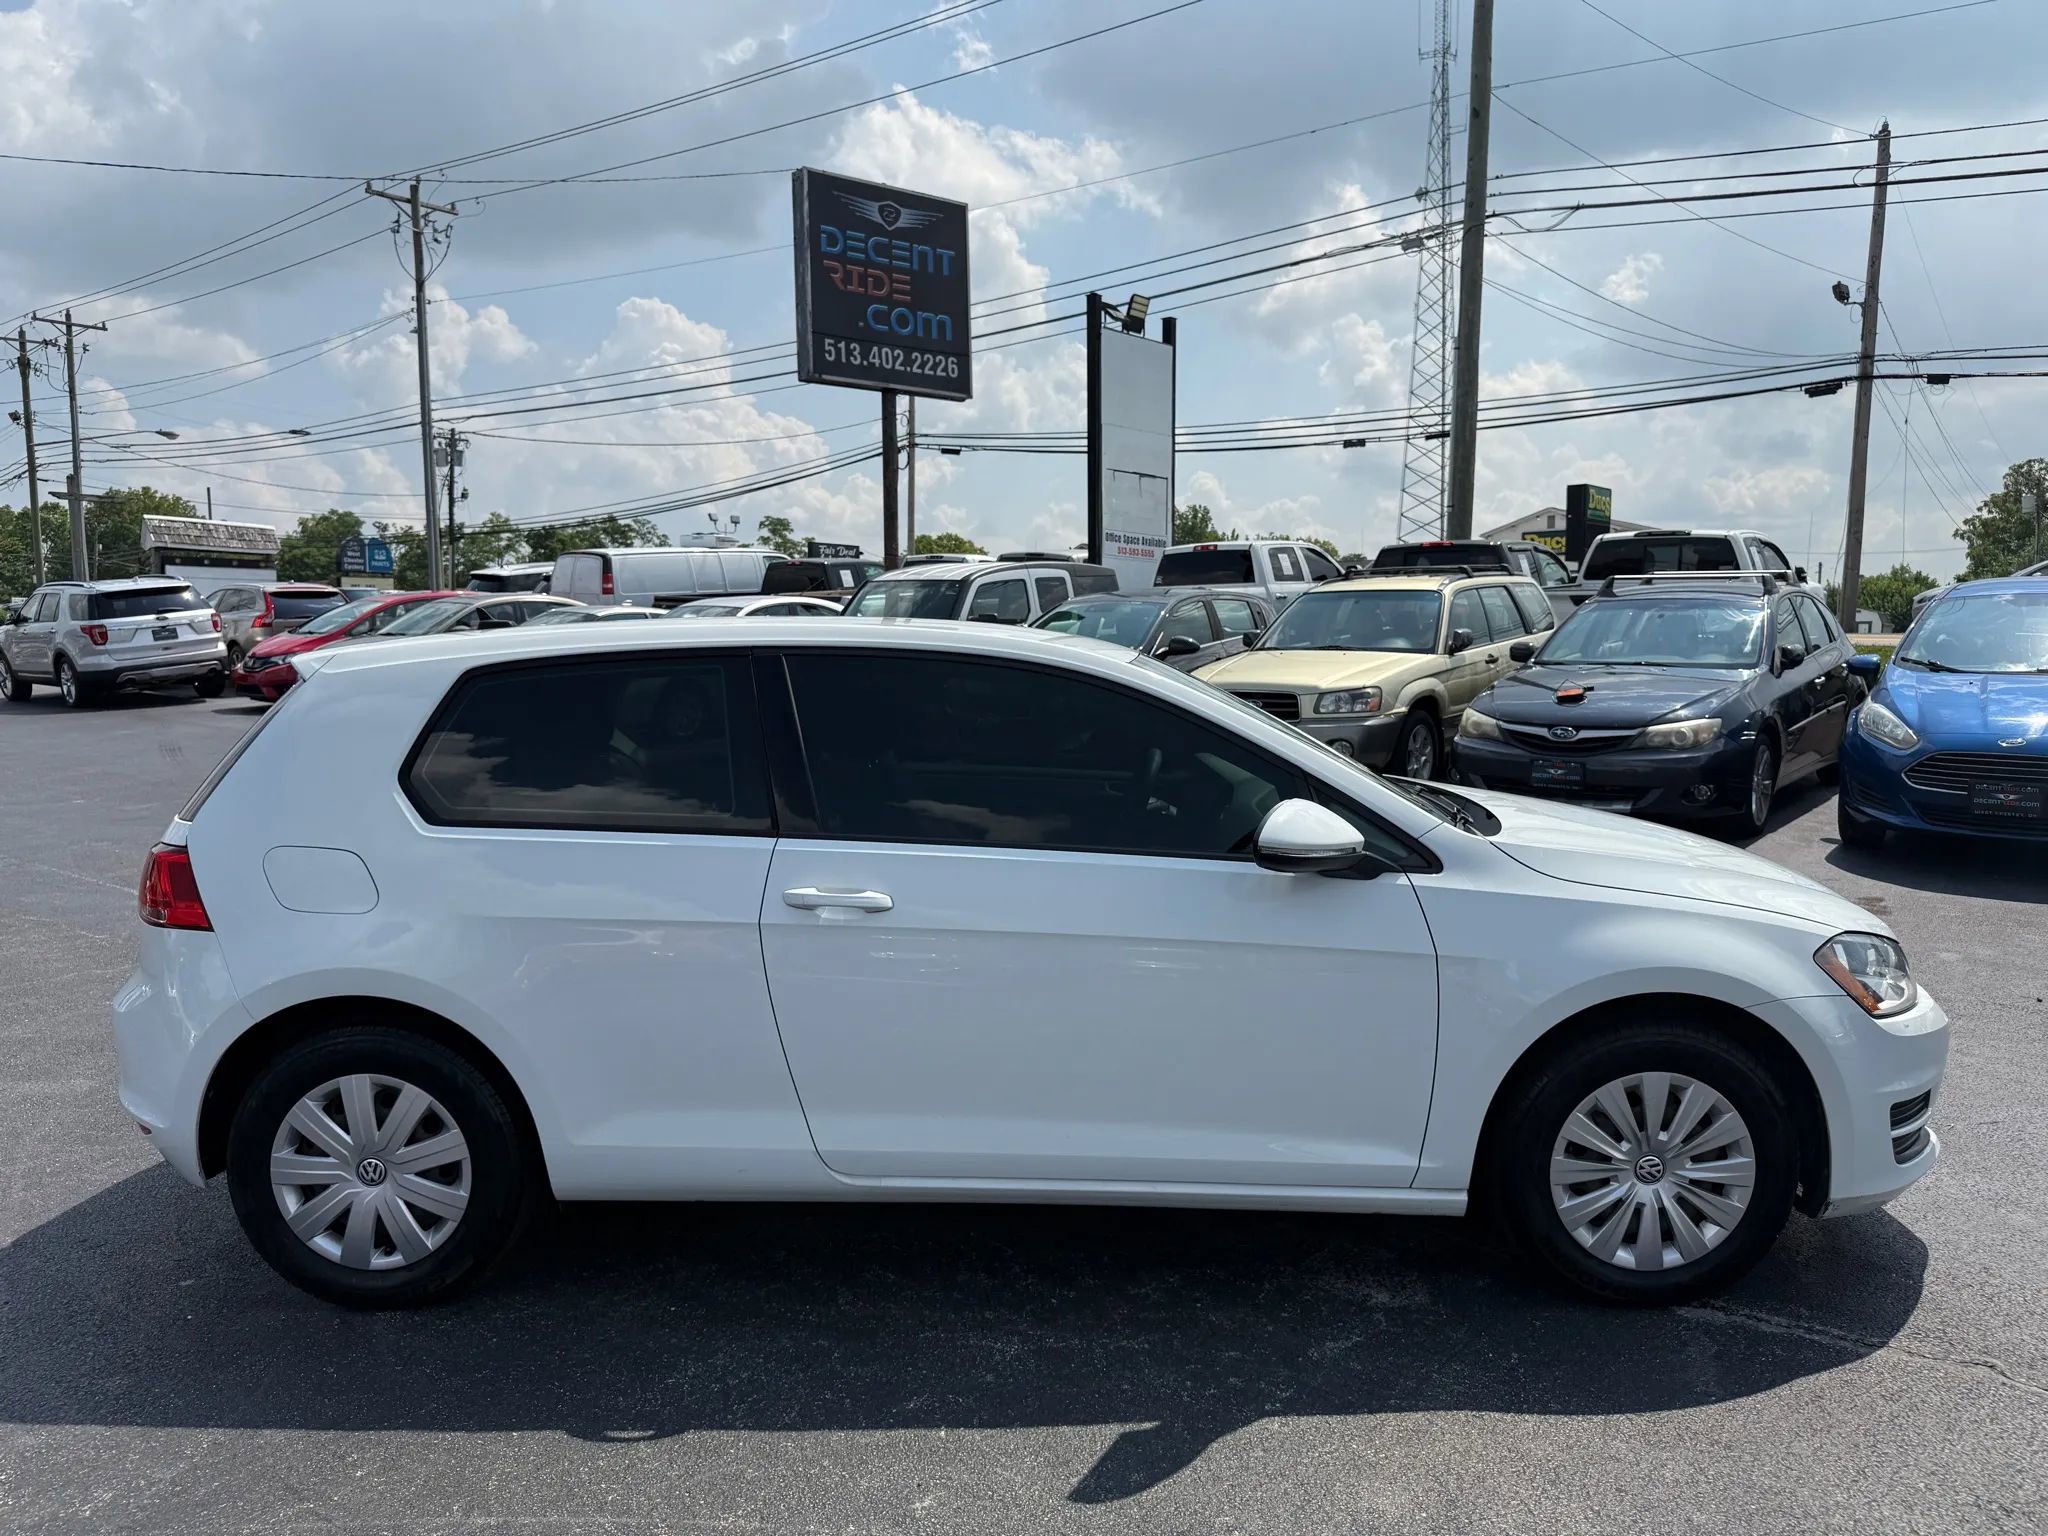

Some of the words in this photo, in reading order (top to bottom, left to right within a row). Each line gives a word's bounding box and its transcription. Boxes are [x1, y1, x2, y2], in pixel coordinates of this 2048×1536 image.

[820, 224, 955, 276] DECENT
[823, 259, 911, 302] RIDE
[824, 338, 959, 378] 513.402.2226
[837, 546, 857, 557] Deal
[1105, 531, 1121, 544] Office
[1122, 534, 1140, 546] Space
[1141, 536, 1167, 549] Available
